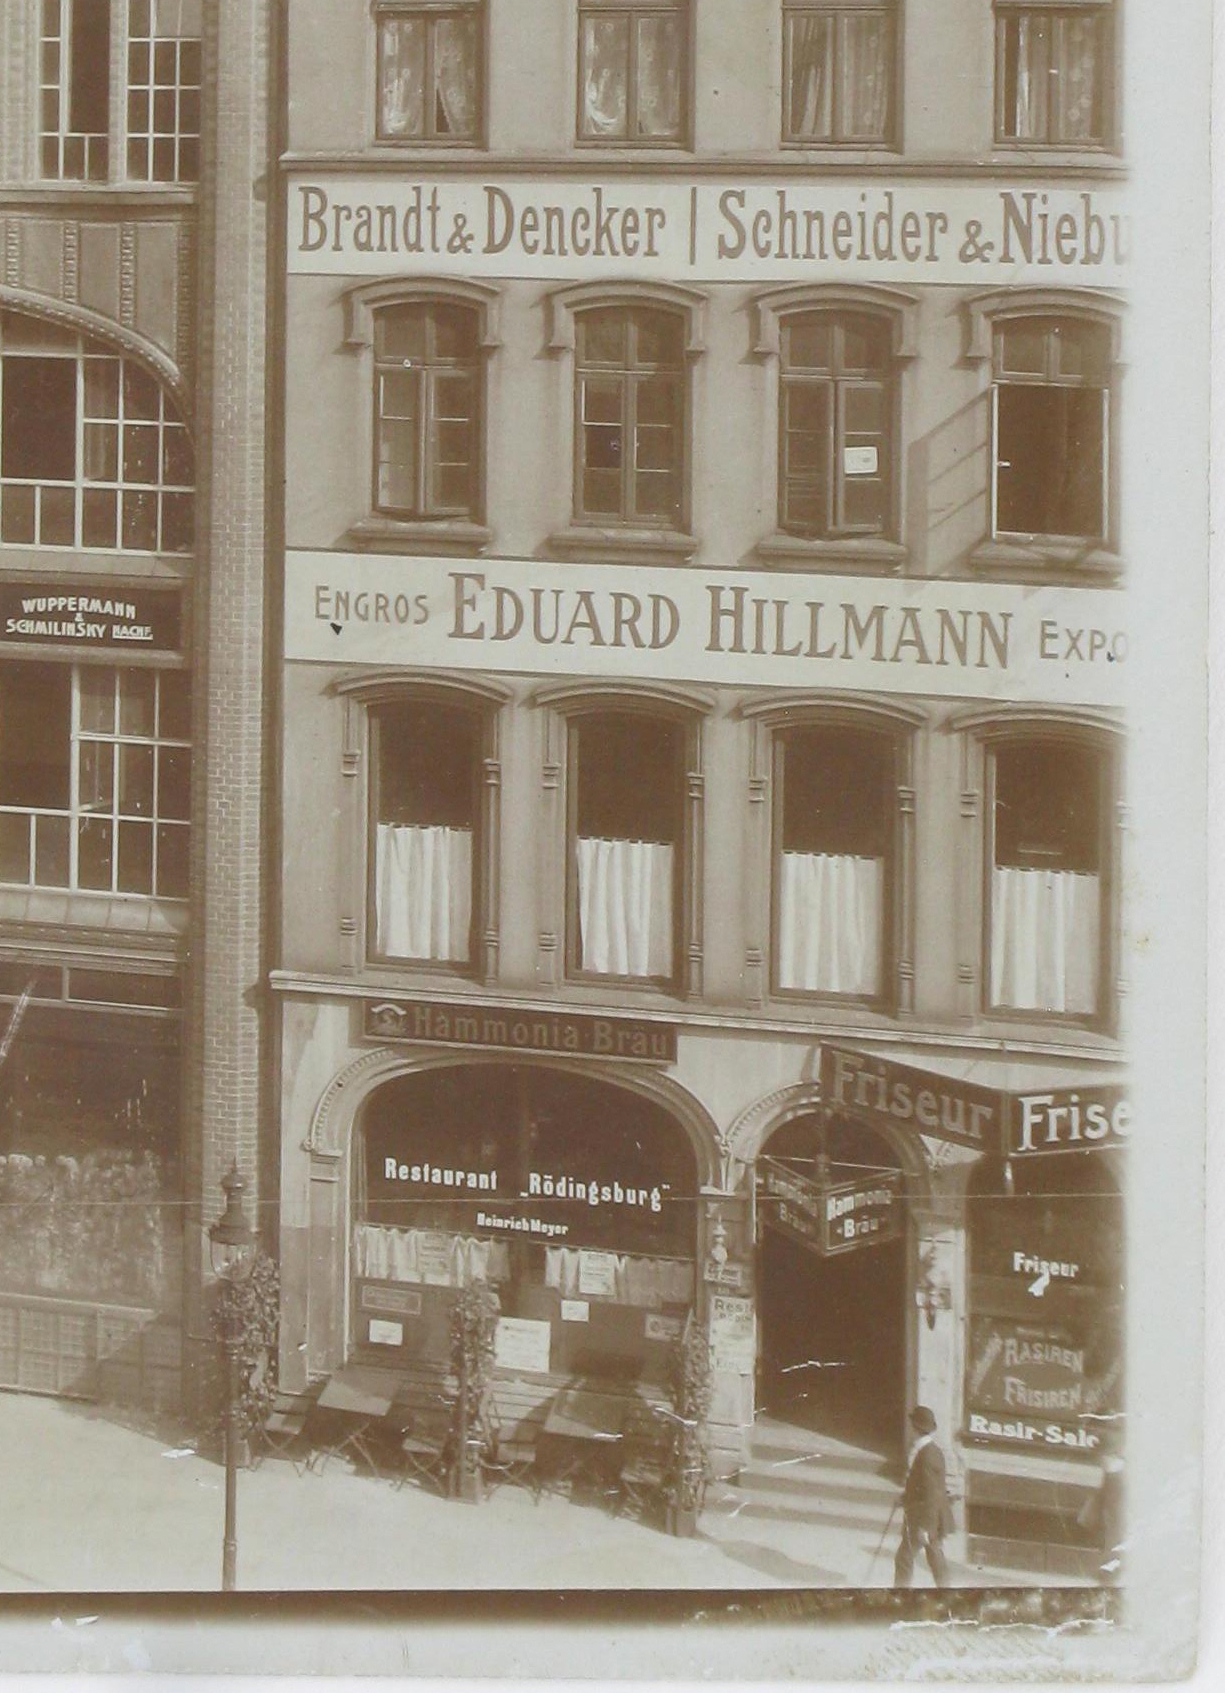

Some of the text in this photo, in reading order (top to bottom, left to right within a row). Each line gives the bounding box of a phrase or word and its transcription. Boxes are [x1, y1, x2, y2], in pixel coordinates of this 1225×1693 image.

[298, 185, 667, 258] Brandt & Dencker
[717, 188, 949, 263] Schneider
[958, 219, 995, 264] &
[21, 596, 136, 620] WUPPERMANN
[314, 584, 429, 626] ENGROS
[447, 571, 682, 650] EDUARD
[704, 584, 1014, 670] HILLMANN
[829, 1050, 994, 1140] Friseur
[384, 1157, 497, 1191] Restaurant
[1012, 1252, 1079, 1278] Friseur
[1003, 1337, 1084, 1374] RASIREN
[1003, 1375, 1082, 1410] FRISIREN
